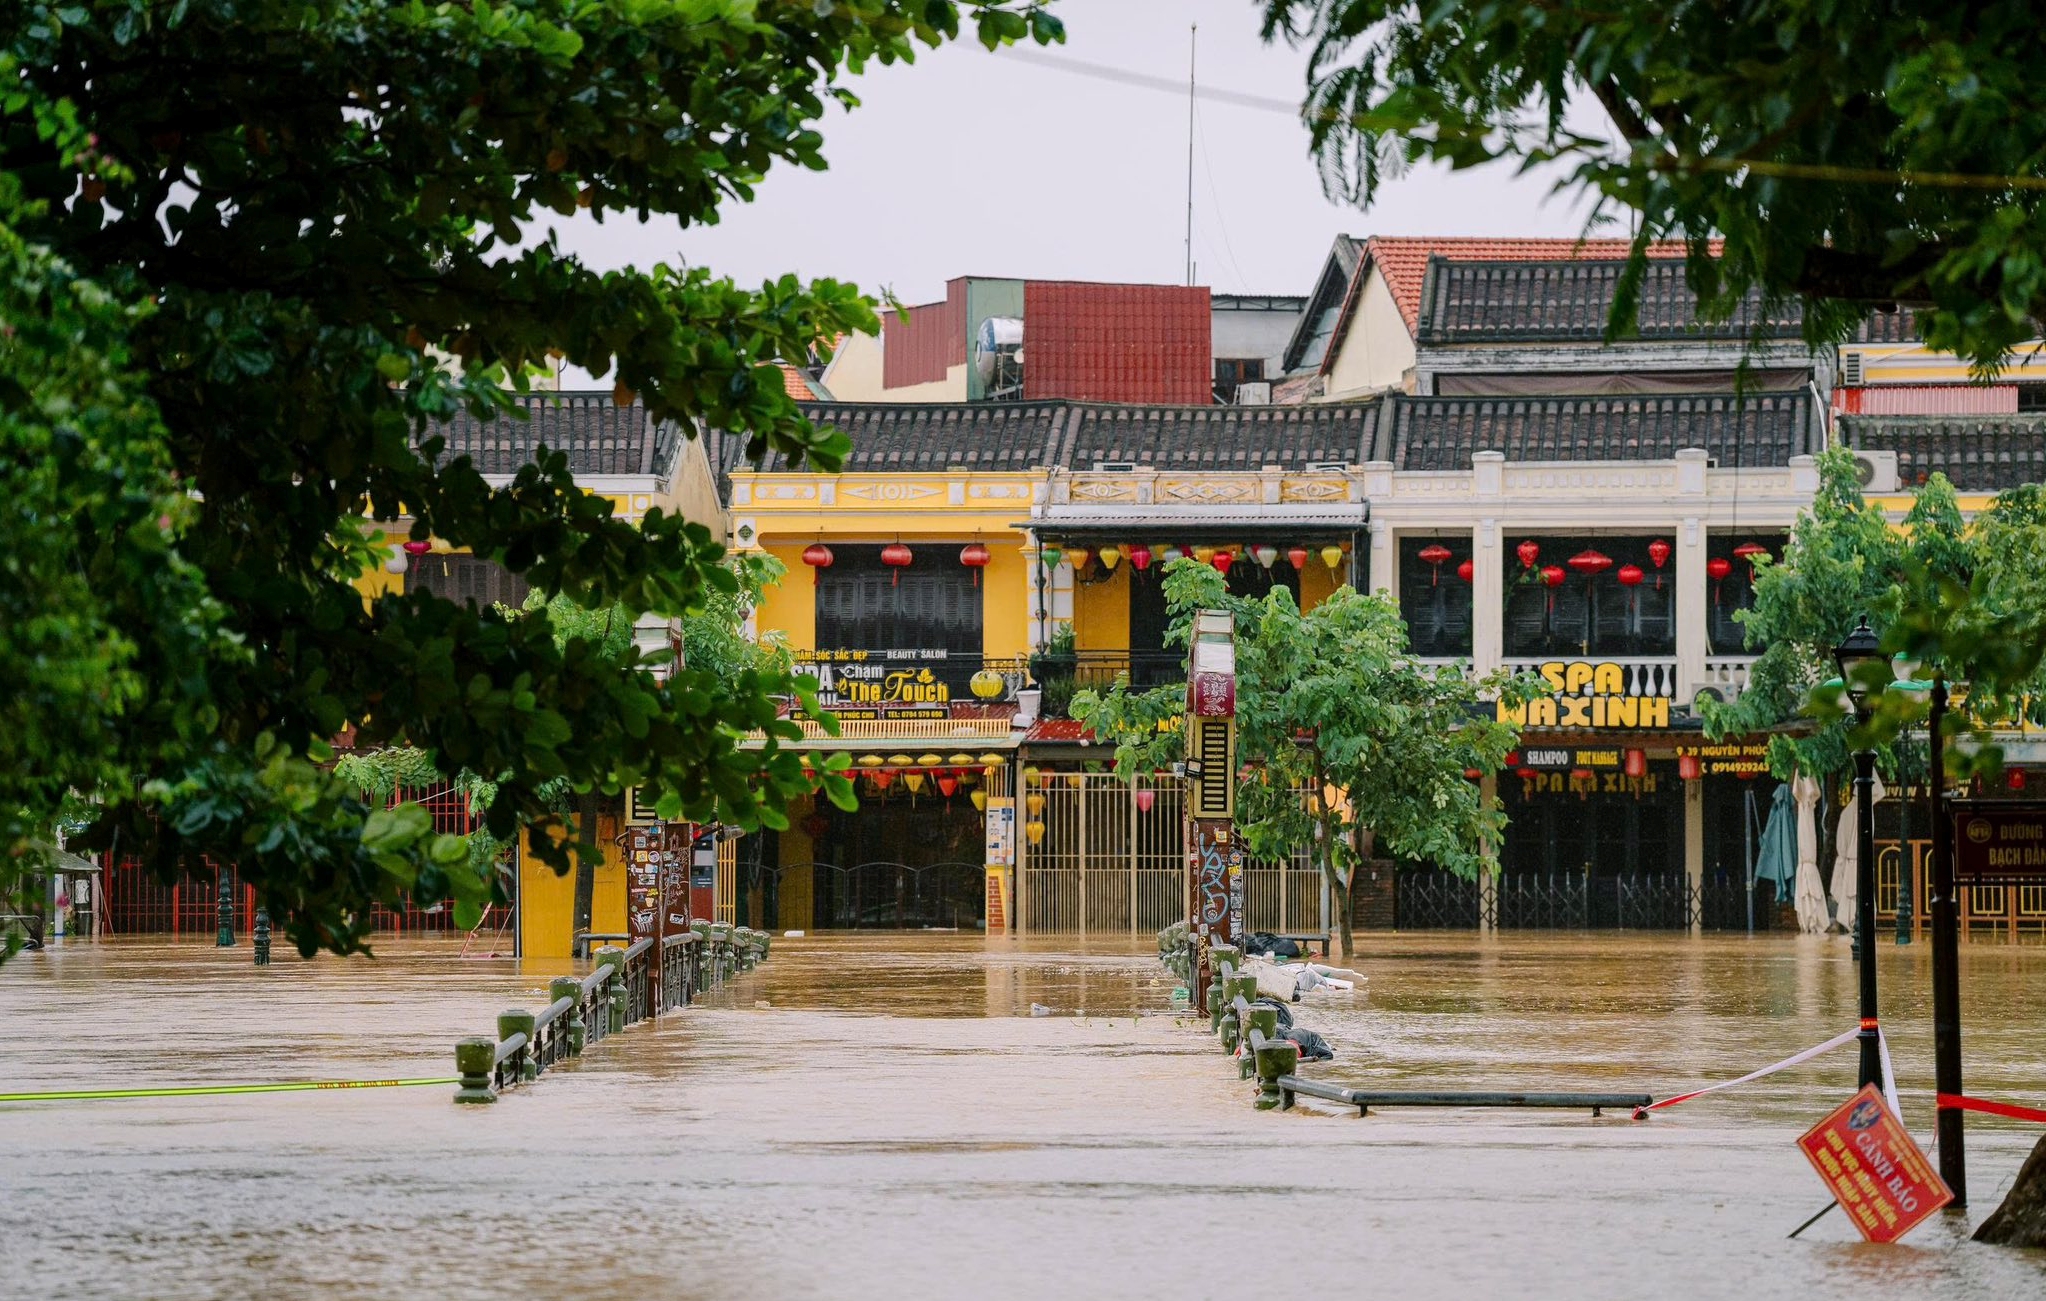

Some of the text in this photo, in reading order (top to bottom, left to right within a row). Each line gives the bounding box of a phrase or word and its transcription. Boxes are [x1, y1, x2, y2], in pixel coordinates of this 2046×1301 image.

[887, 650, 947, 659] BEAUTY SALON
[842, 665, 883, 680] Chạm
[1541, 662, 1623, 693] SPA
[850, 667, 948, 702] The Touch
[1527, 751, 1568, 765] SHAMPOO
[1687, 747, 1698, 757] 39
[1989, 847, 2021, 867] BẠCH
[1855, 1132, 1895, 1180] CẢNH
[1886, 1176, 1918, 1213] BÁO
